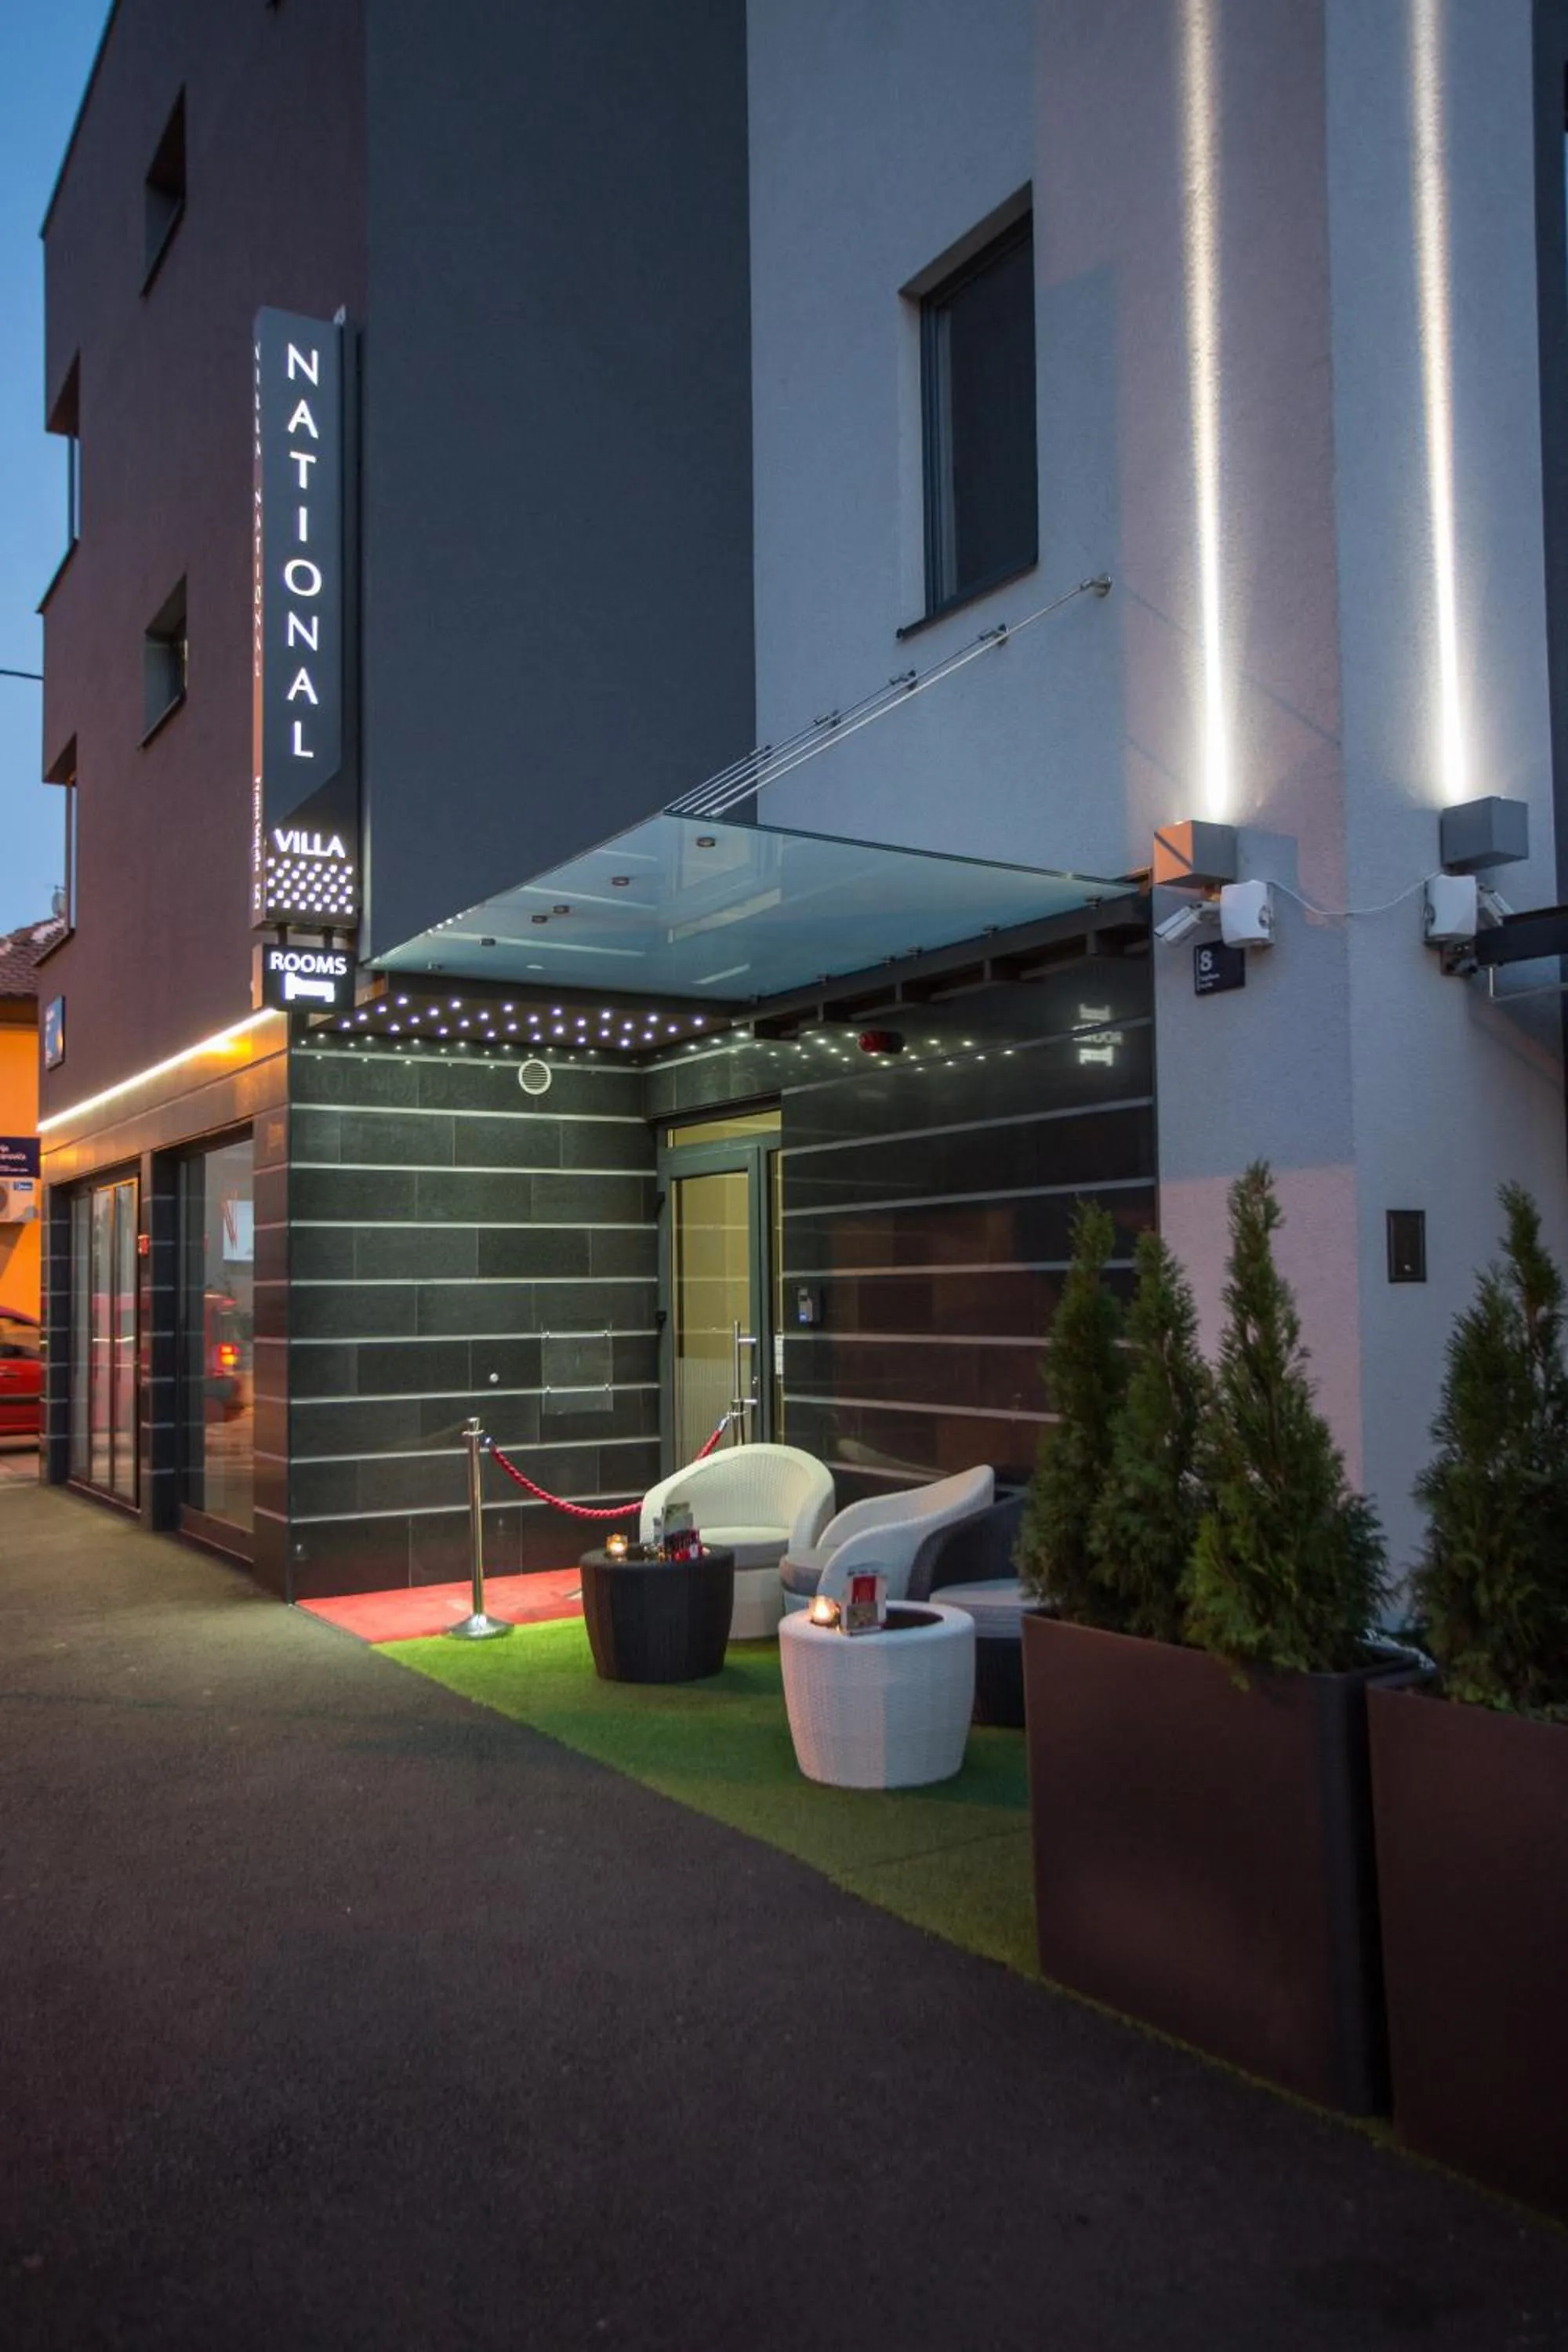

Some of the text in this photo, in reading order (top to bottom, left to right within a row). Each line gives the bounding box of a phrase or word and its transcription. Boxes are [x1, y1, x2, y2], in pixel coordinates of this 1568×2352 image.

[284, 343, 322, 759] NATIONAL
[274, 828, 346, 858] VILLA
[270, 951, 347, 976] ROOMS
[1200, 949, 1213, 971] 8
